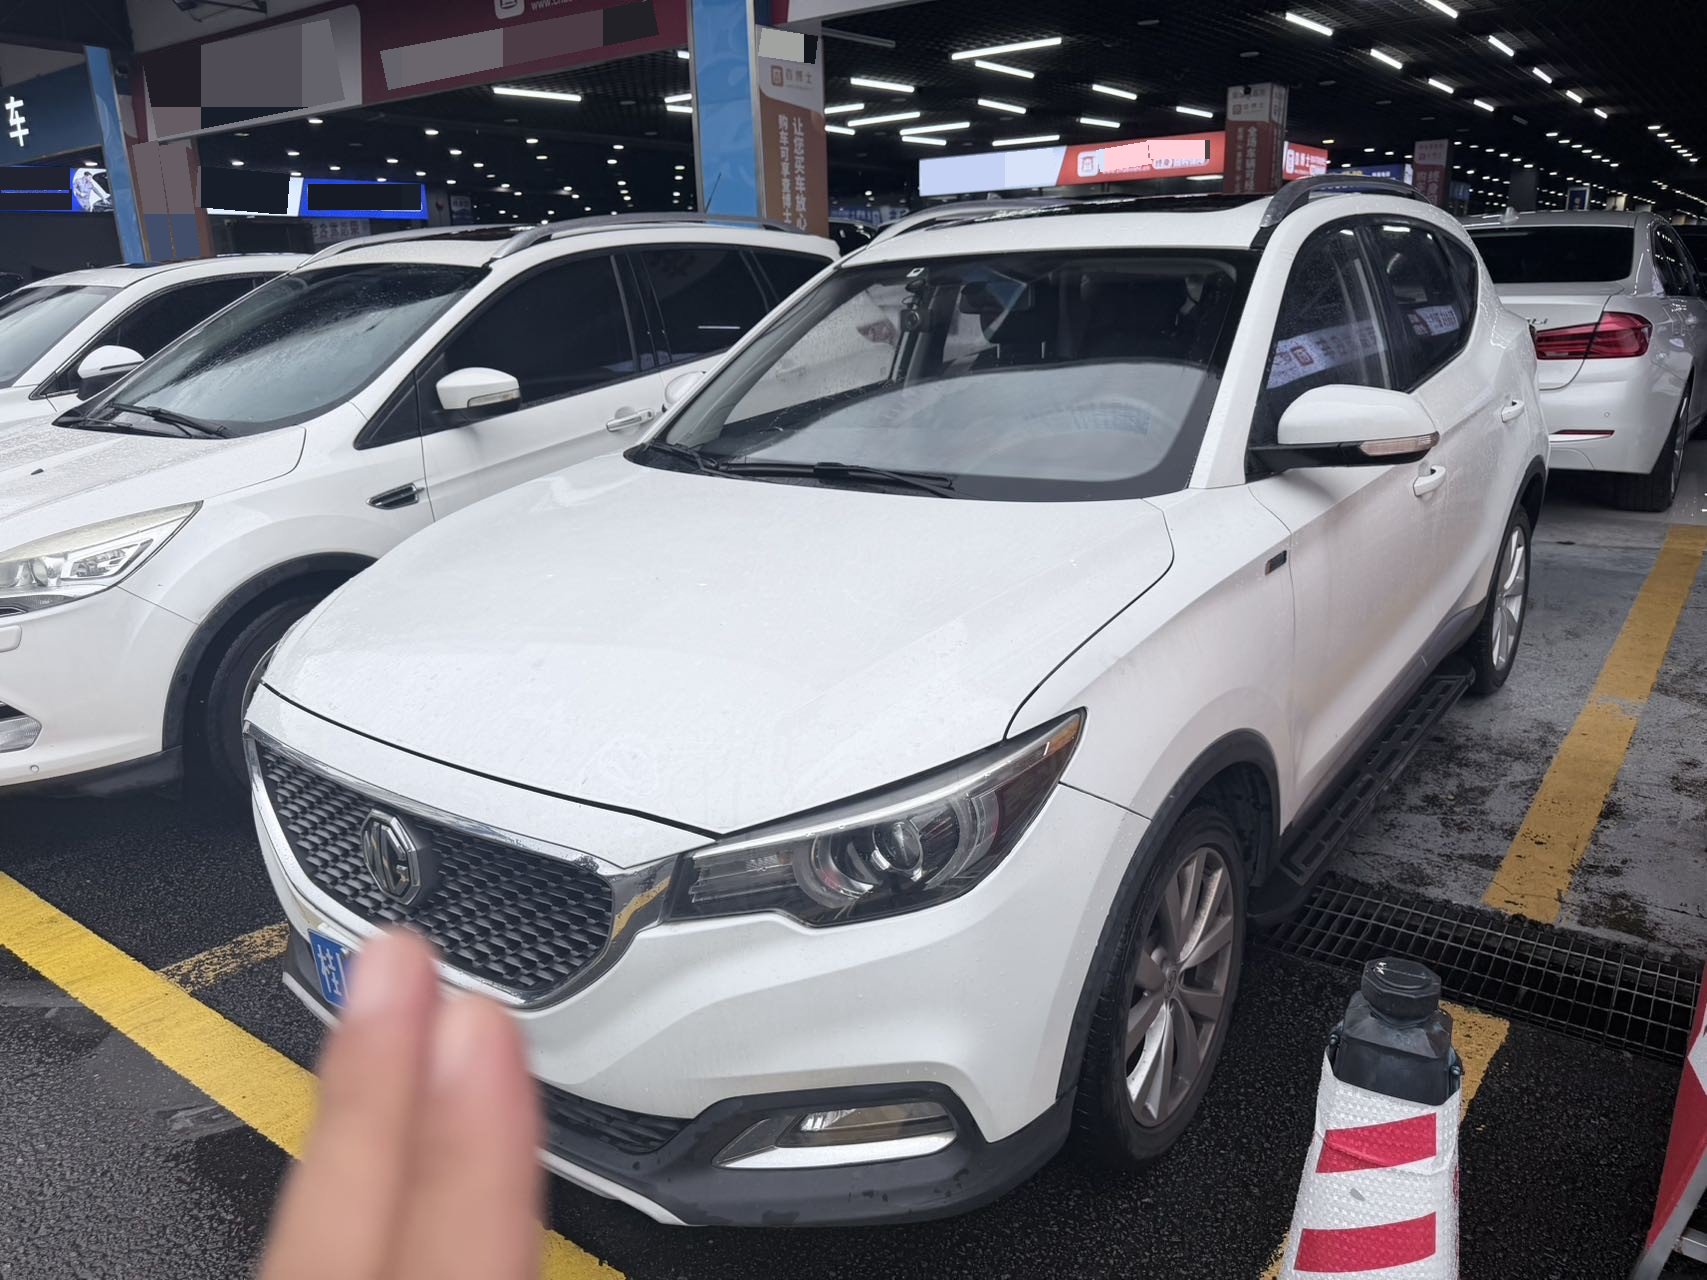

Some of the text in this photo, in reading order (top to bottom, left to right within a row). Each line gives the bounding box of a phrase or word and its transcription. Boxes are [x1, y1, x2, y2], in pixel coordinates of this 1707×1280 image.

[5, 95, 29, 147] 车
[792, 116, 808, 232] 让您买车放心
[363, 814, 416, 902] MG
